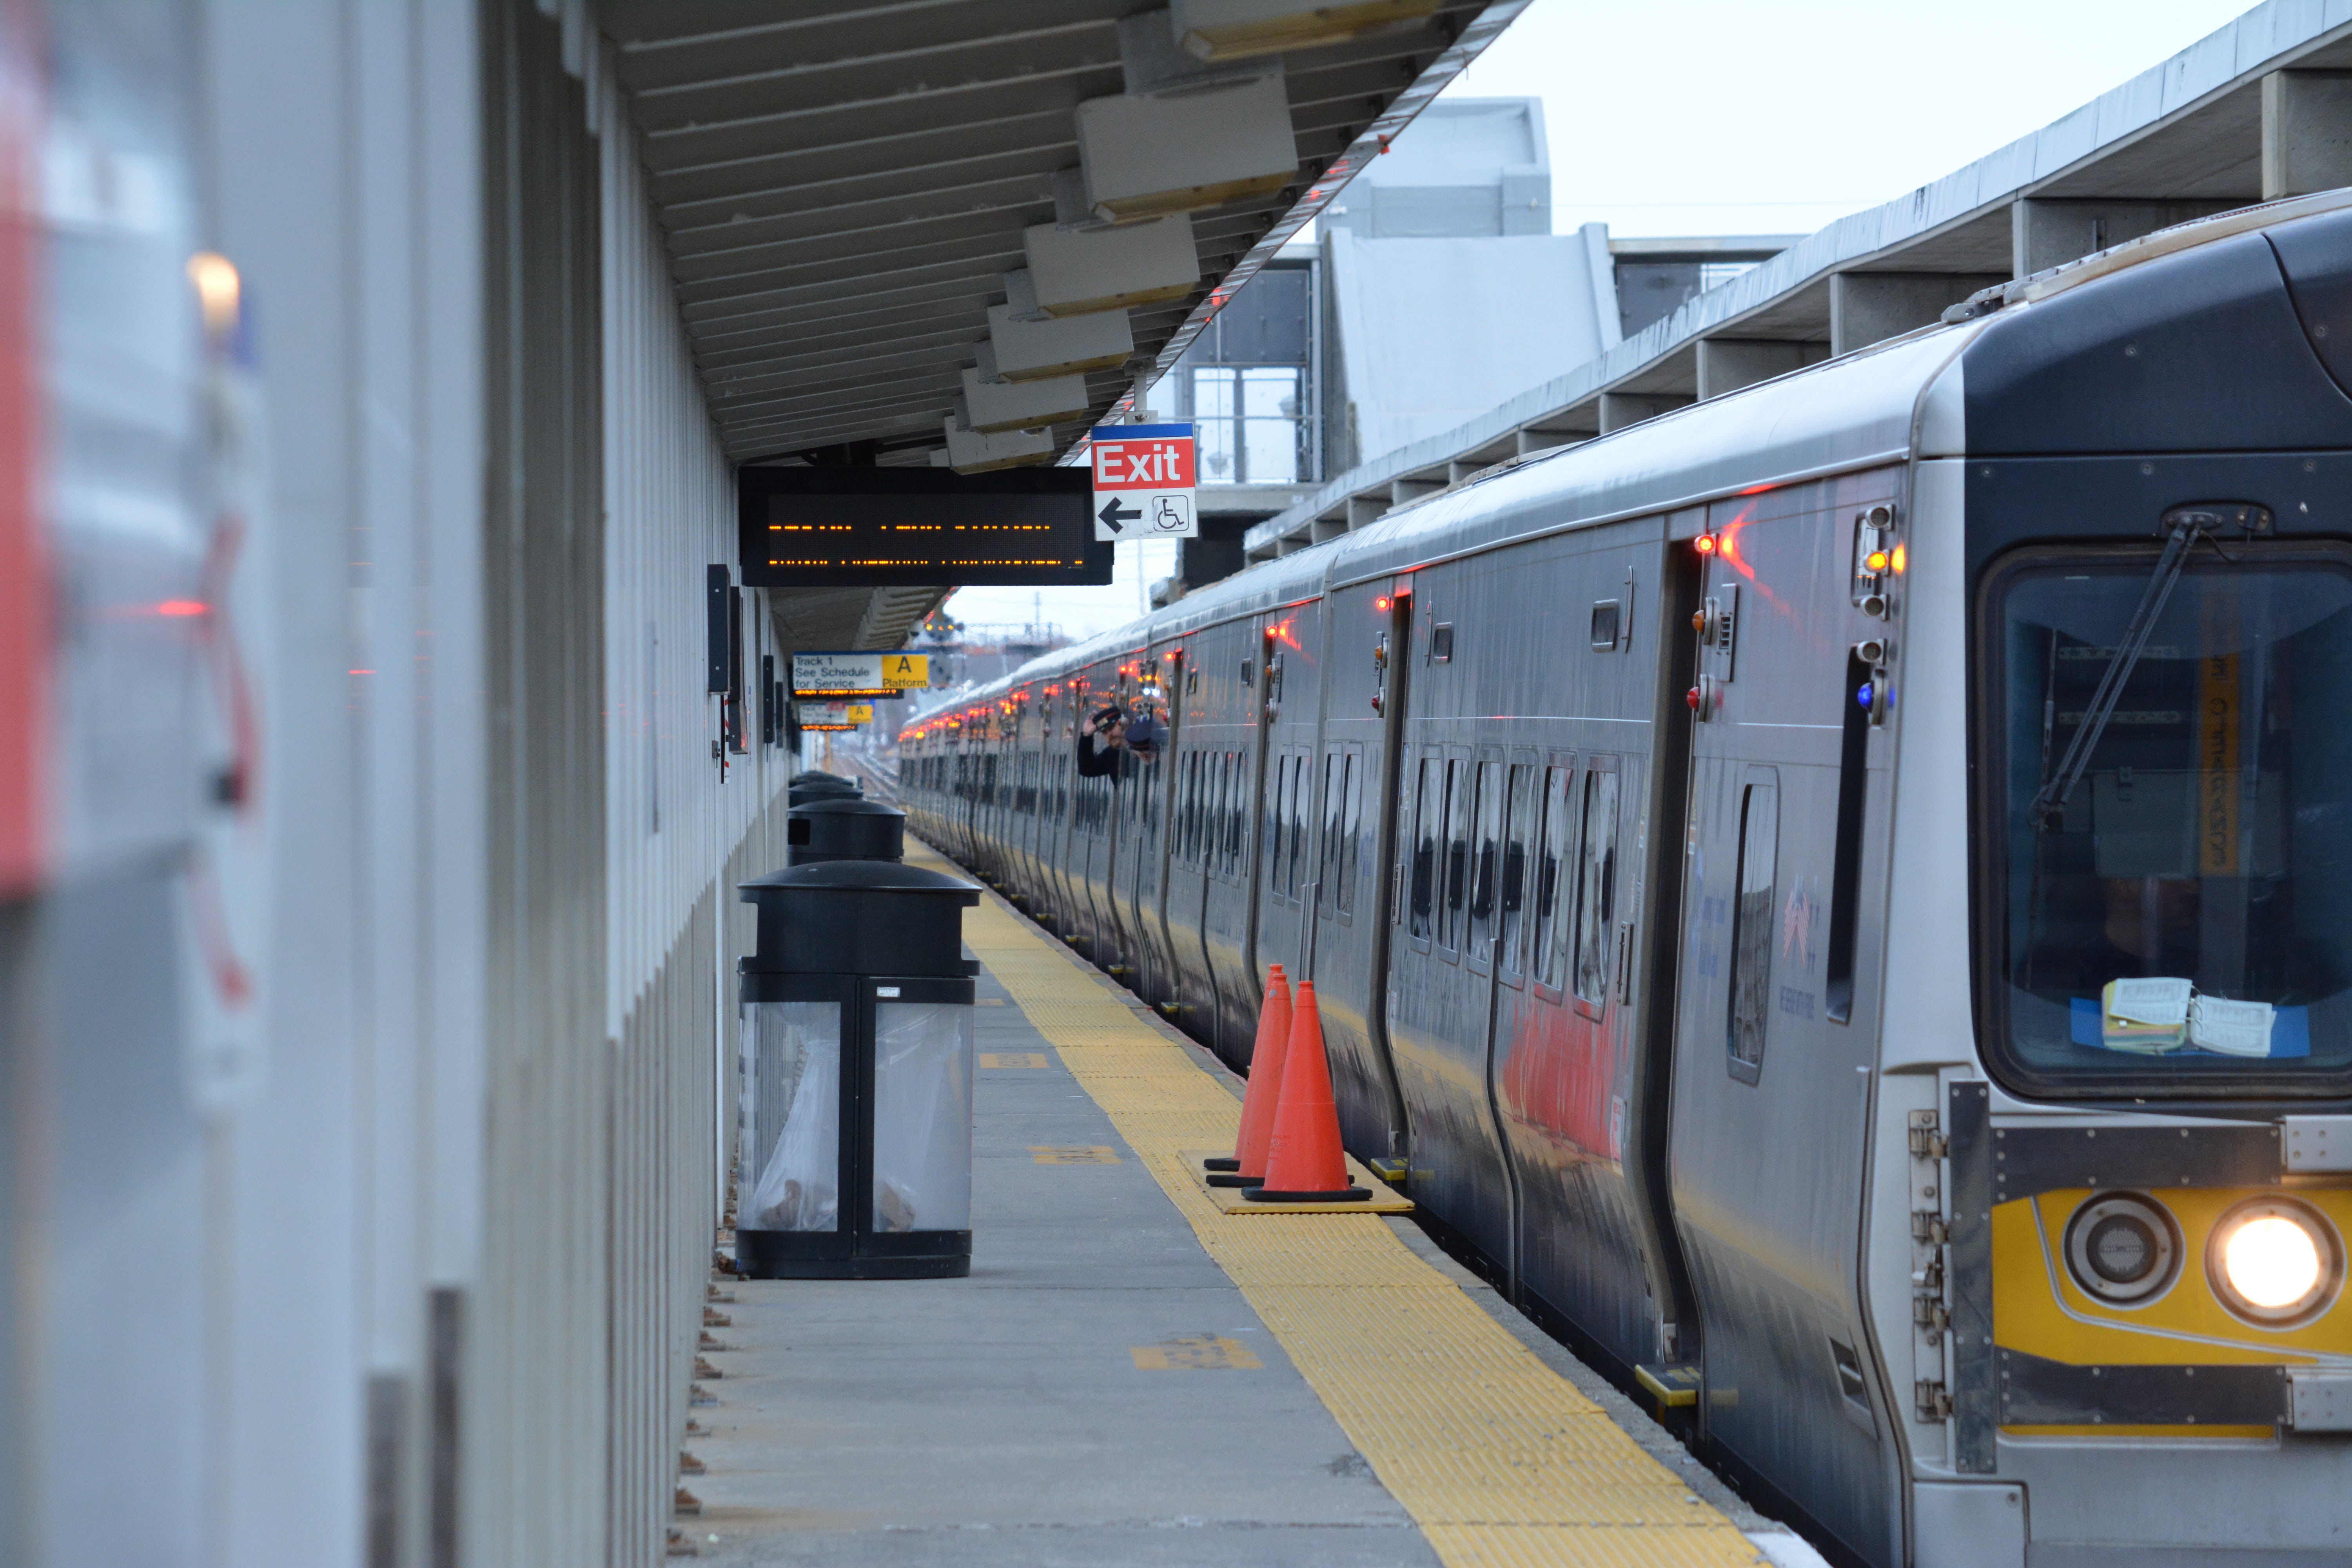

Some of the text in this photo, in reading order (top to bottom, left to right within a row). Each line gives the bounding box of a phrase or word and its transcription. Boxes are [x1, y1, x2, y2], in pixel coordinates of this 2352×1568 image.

[1096, 444, 1181, 483] Exit
[796, 657, 833, 665] Track 1
[897, 656, 912, 673] A
[795, 667, 870, 677] See Schedule
[796, 678, 855, 688] for Service
[882, 678, 927, 687] Platform
[856, 706, 864, 715] A
